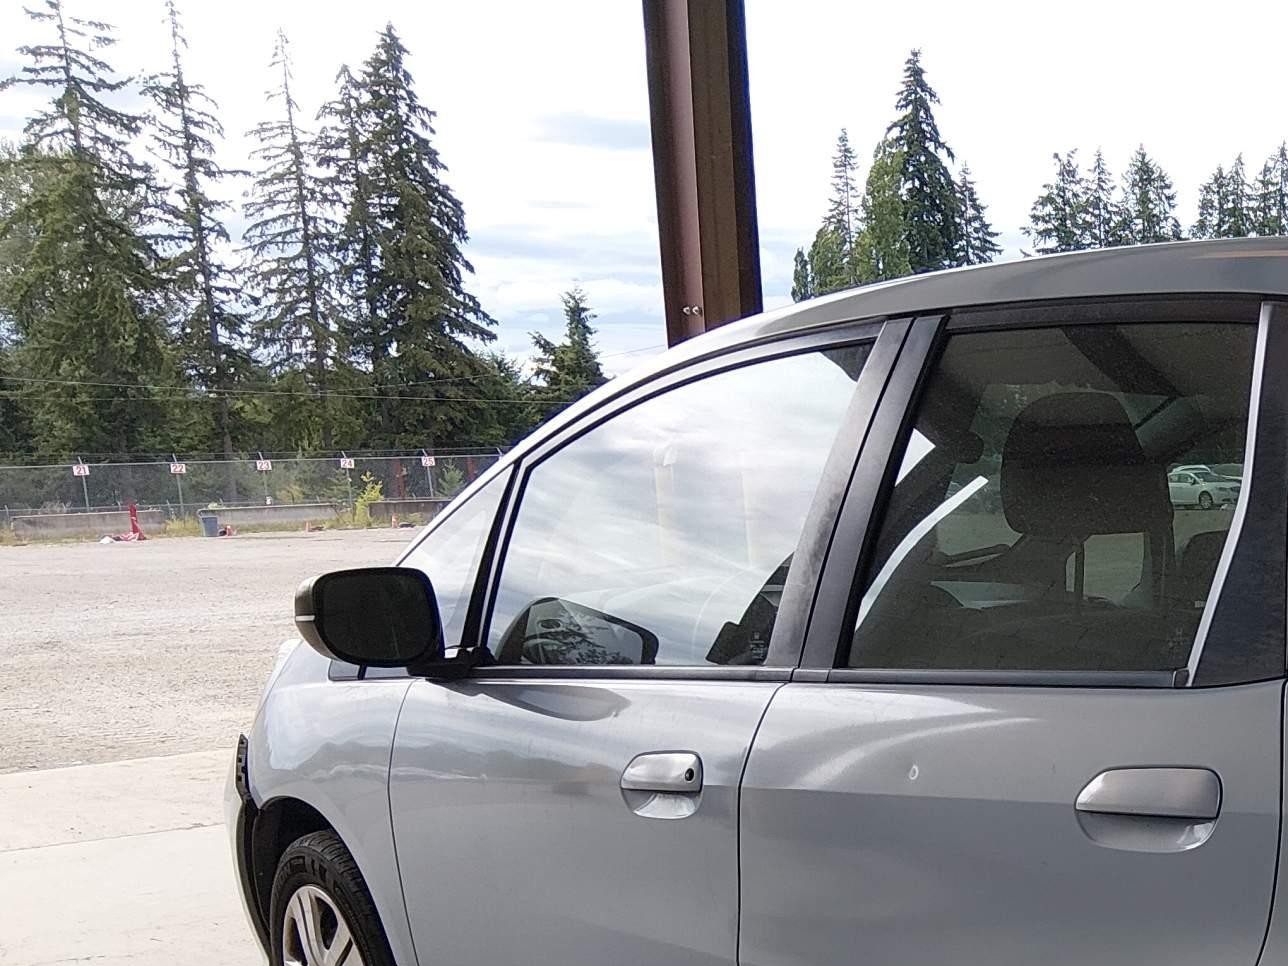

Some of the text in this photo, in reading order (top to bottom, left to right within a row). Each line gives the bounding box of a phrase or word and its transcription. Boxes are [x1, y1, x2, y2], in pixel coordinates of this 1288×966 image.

[258, 460, 270, 470] 23
[342, 458, 353, 467] 24
[423, 457, 434, 466] 25
[76, 465, 87, 474] 21
[172, 464, 184, 473] 22
